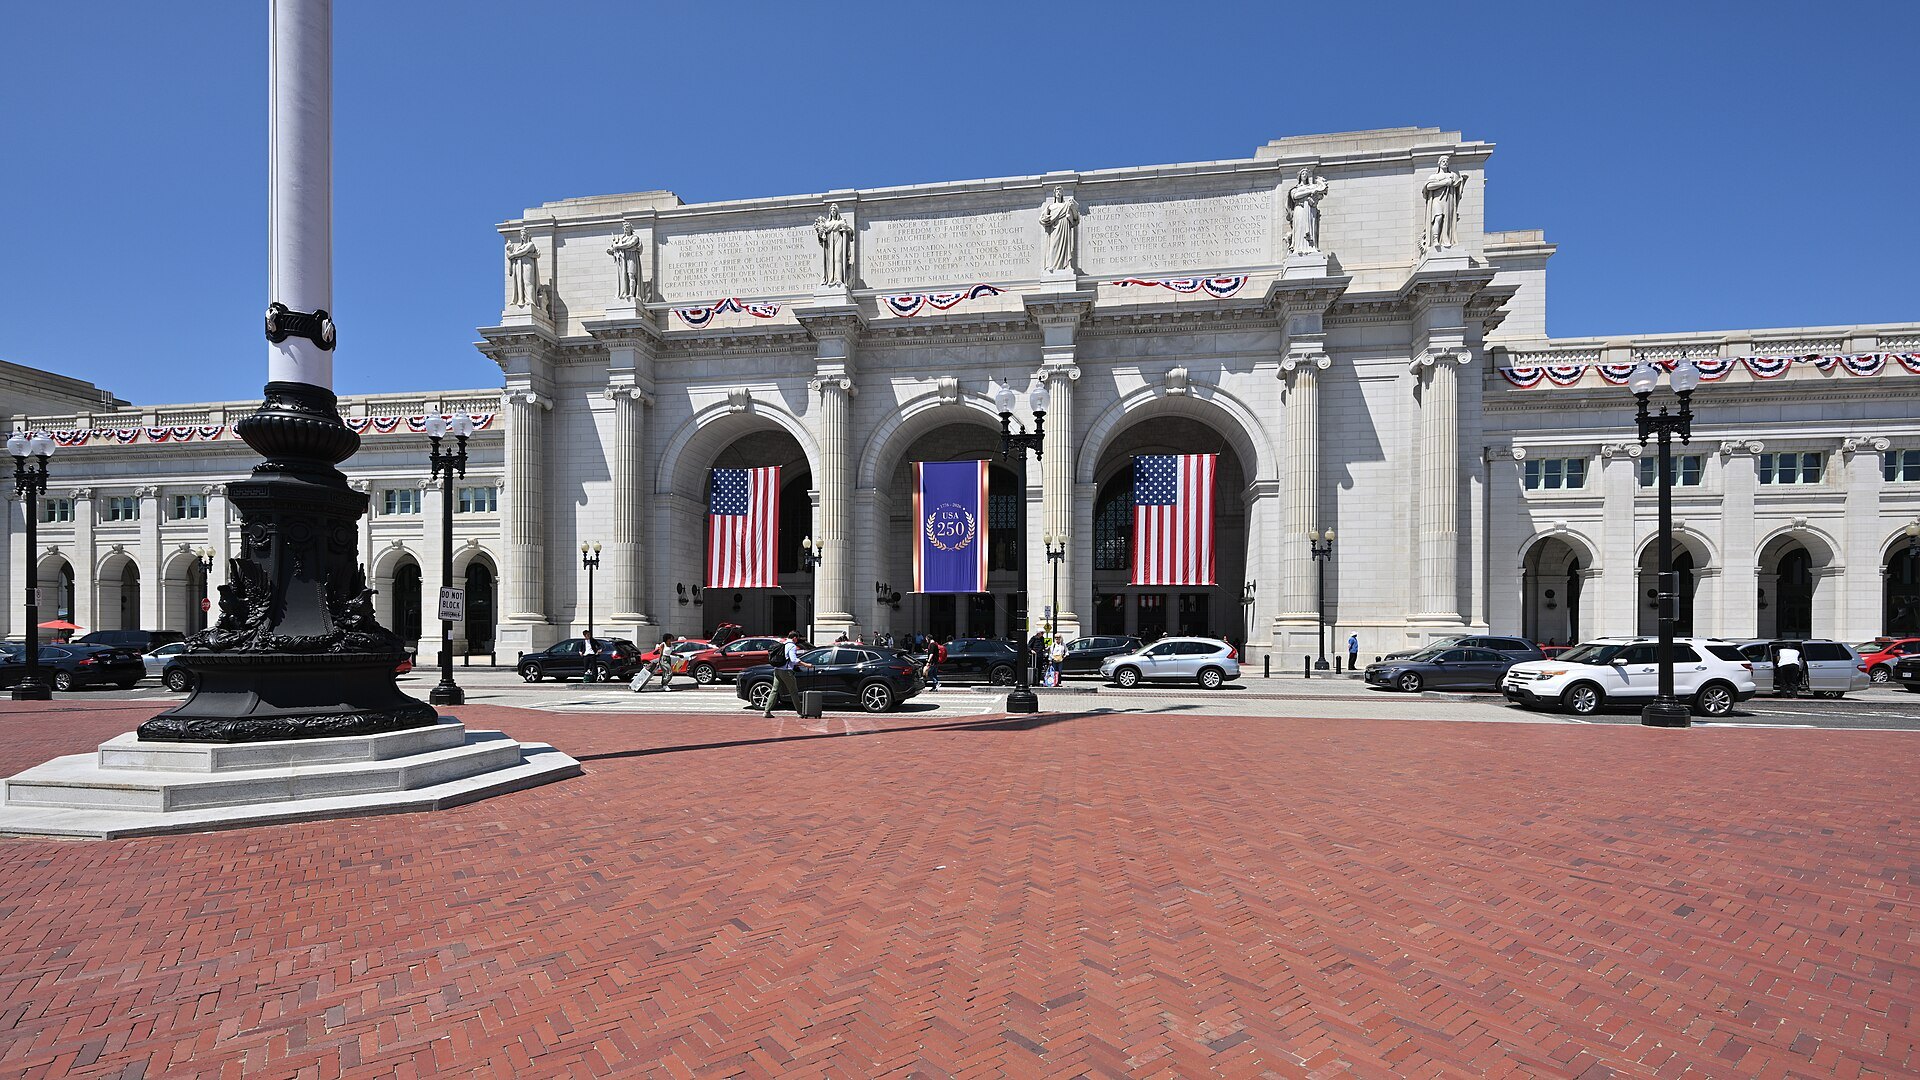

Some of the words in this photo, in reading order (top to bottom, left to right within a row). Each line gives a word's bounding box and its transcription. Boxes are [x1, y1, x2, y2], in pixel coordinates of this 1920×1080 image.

[1130, 203, 1166, 212] NATIONAL
[1170, 201, 1200, 209] WEALTH
[1209, 197, 1256, 206] FOUNDATION
[1084, 213, 1120, 221] CIVILIZED
[1125, 210, 1156, 219] SOCIETY
[1184, 206, 1216, 215] NATURAL
[1222, 203, 1271, 212] PROVIDENCE
[1124, 222, 1163, 230] MECHANIC
[1194, 216, 1246, 225] CONTROLLING
[894, 233, 936, 242] DAUGHTERS
[990, 227, 1024, 235] THOUGHT
[1172, 226, 1210, 234] HIGHWAYS
[900, 244, 945, 252] IMAGINATION
[966, 239, 1008, 248] CONCEIVED
[1130, 235, 1167, 244] OVERRIDE
[1191, 239, 1218, 247] HUMAN
[1224, 236, 1260, 245] THOUGHT
[1224, 248, 1261, 256] BLOSSOM
[668, 261, 708, 269] ELECTRICITY
[870, 266, 911, 274] PHILOSOPHY
[937, 522, 964, 536] 250
